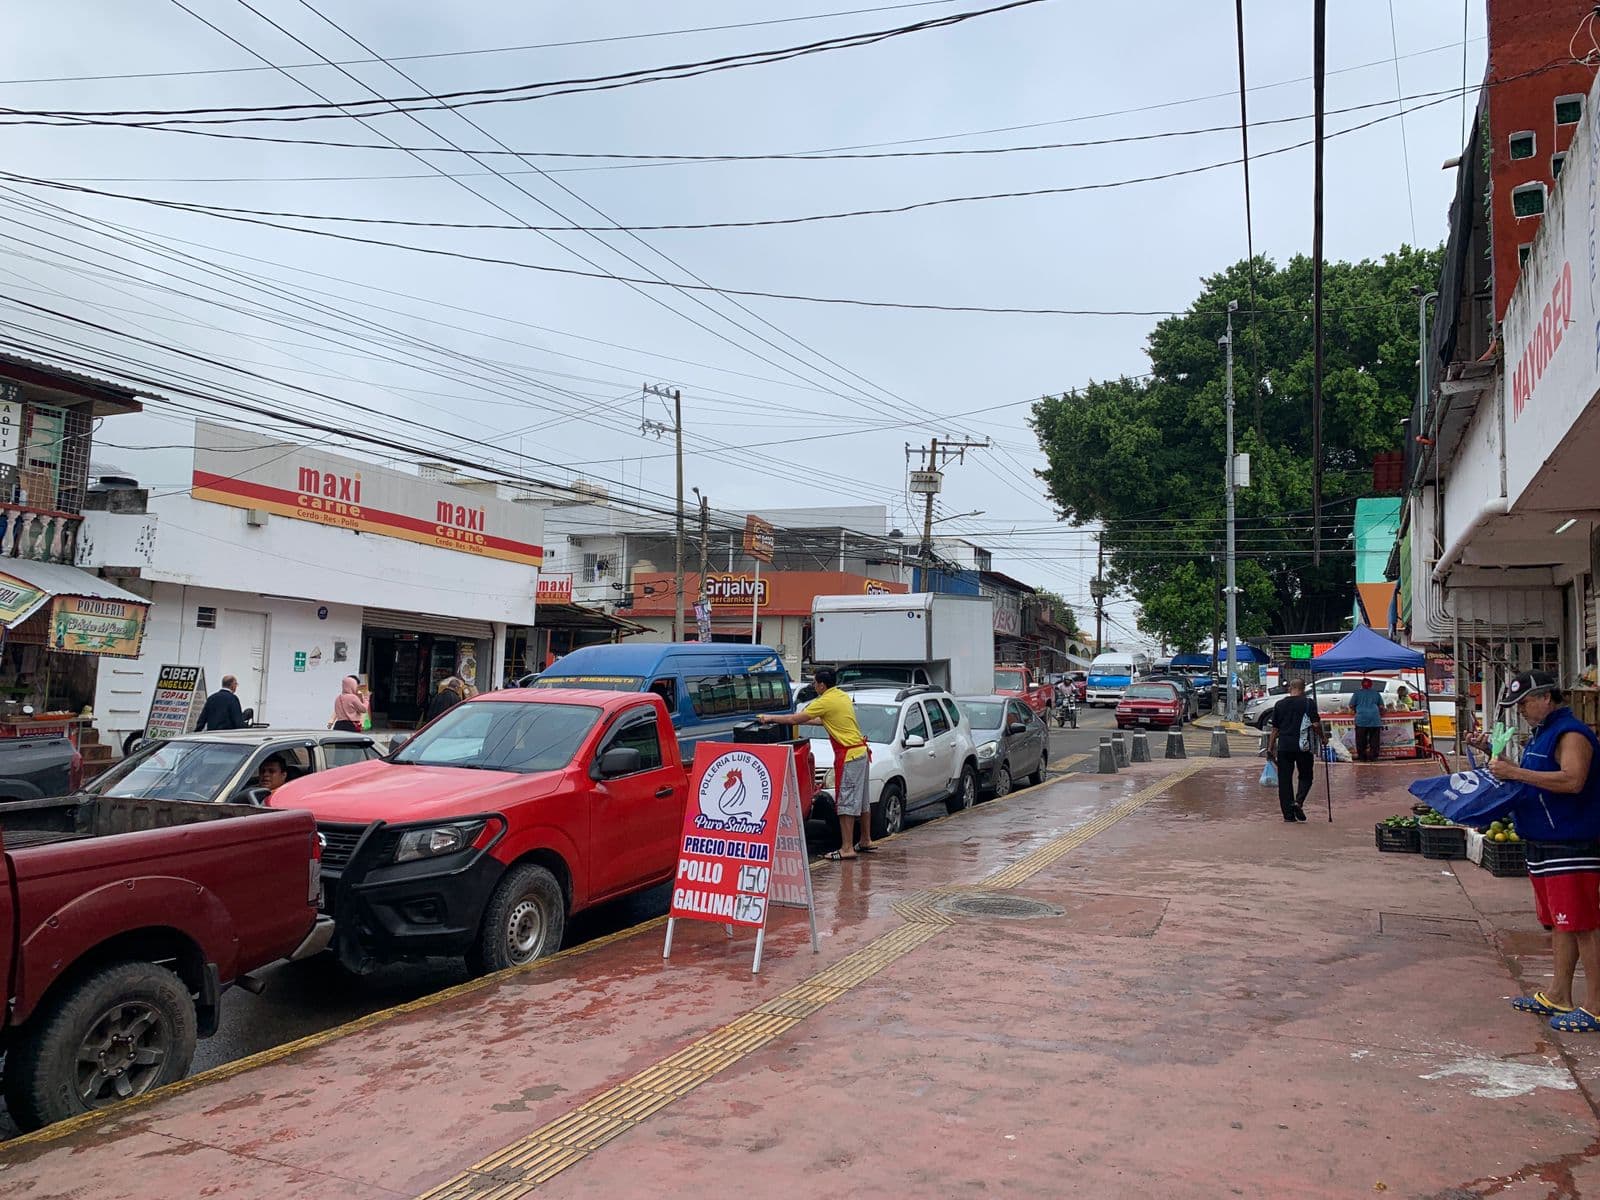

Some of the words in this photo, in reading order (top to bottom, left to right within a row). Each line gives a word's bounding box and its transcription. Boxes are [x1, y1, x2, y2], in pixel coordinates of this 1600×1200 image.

[1513, 261, 1573, 422] MAYOREO
[298, 467, 361, 503] maxi
[297, 495, 361, 518] carne
[437, 500, 486, 531] maxi
[296, 509, 320, 520] Cerdo
[323, 514, 337, 523] Res
[341, 518, 359, 528] Pollo
[435, 525, 484, 545] carne
[435, 537, 452, 546] Cerdo
[455, 541, 466, 549] Res
[468, 544, 483, 553] Pollo
[538, 577, 570, 591] maxi
[706, 578, 764, 597] Grijalva
[77, 600, 125, 616] POZOLERIA
[161, 667, 197, 681] CIBER
[158, 680, 195, 690] ANGELUZ
[161, 691, 188, 700] COPIAS
[701, 756, 731, 796] POLLERIA
[731, 754, 751, 764] LUIS
[751, 761, 769, 801] ENRIQUE
[694, 814, 723, 831] Puro
[684, 837, 725, 856] PRECIO
[727, 842, 746, 858] DEL
[748, 844, 768, 860] DIA
[677, 859, 723, 884] POLLO
[739, 865, 768, 893] 150
[673, 888, 734, 917] GALLINA
[735, 895, 764, 921] 175
